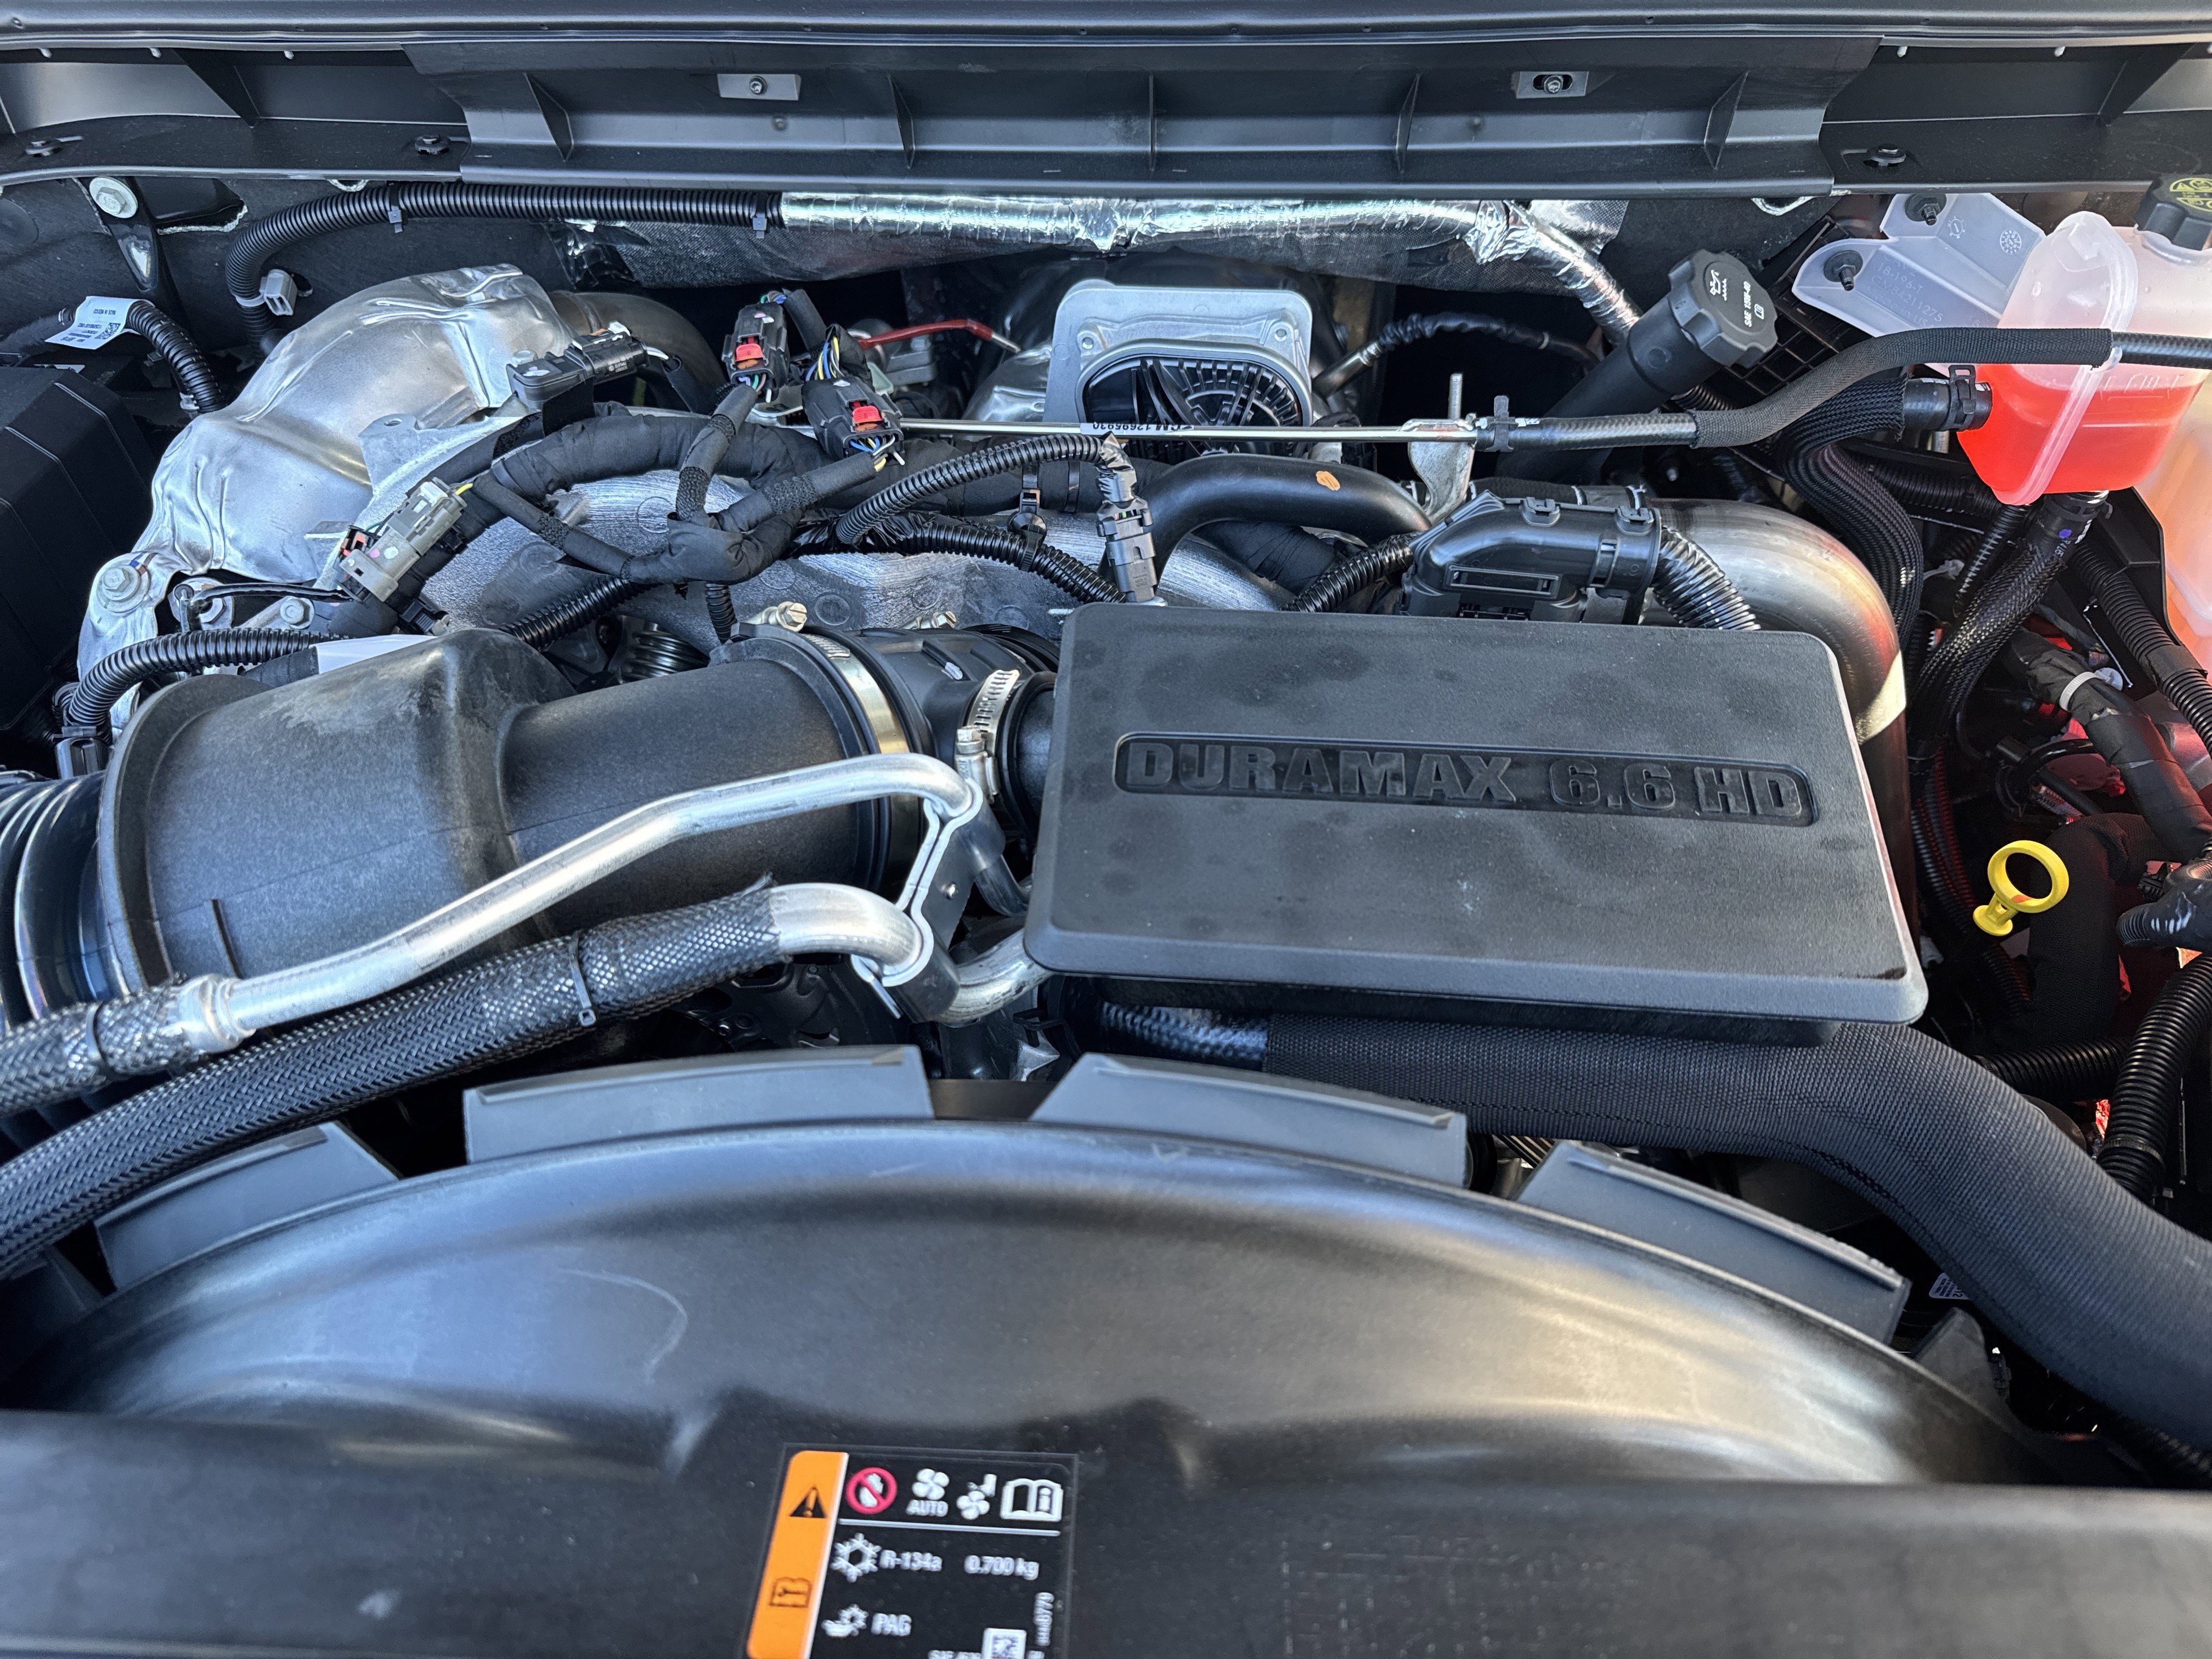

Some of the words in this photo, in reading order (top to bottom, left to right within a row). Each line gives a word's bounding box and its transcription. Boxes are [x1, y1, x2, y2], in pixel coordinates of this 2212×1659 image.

[1878, 262, 1923, 294] 18-196-T
[1871, 275, 1944, 322] GM84211275
[1743, 310, 1752, 328] SAE
[1125, 741, 1516, 803] DURAMAX
[1549, 759, 1676, 811] 6.6
[1695, 766, 1803, 818] HD
[906, 1499, 949, 1517] AUTO
[880, 1549, 943, 1572] R-134a
[963, 1554, 1014, 1576] 0.700
[1014, 1557, 1040, 1581] kg
[871, 1613, 912, 1637] PAG
